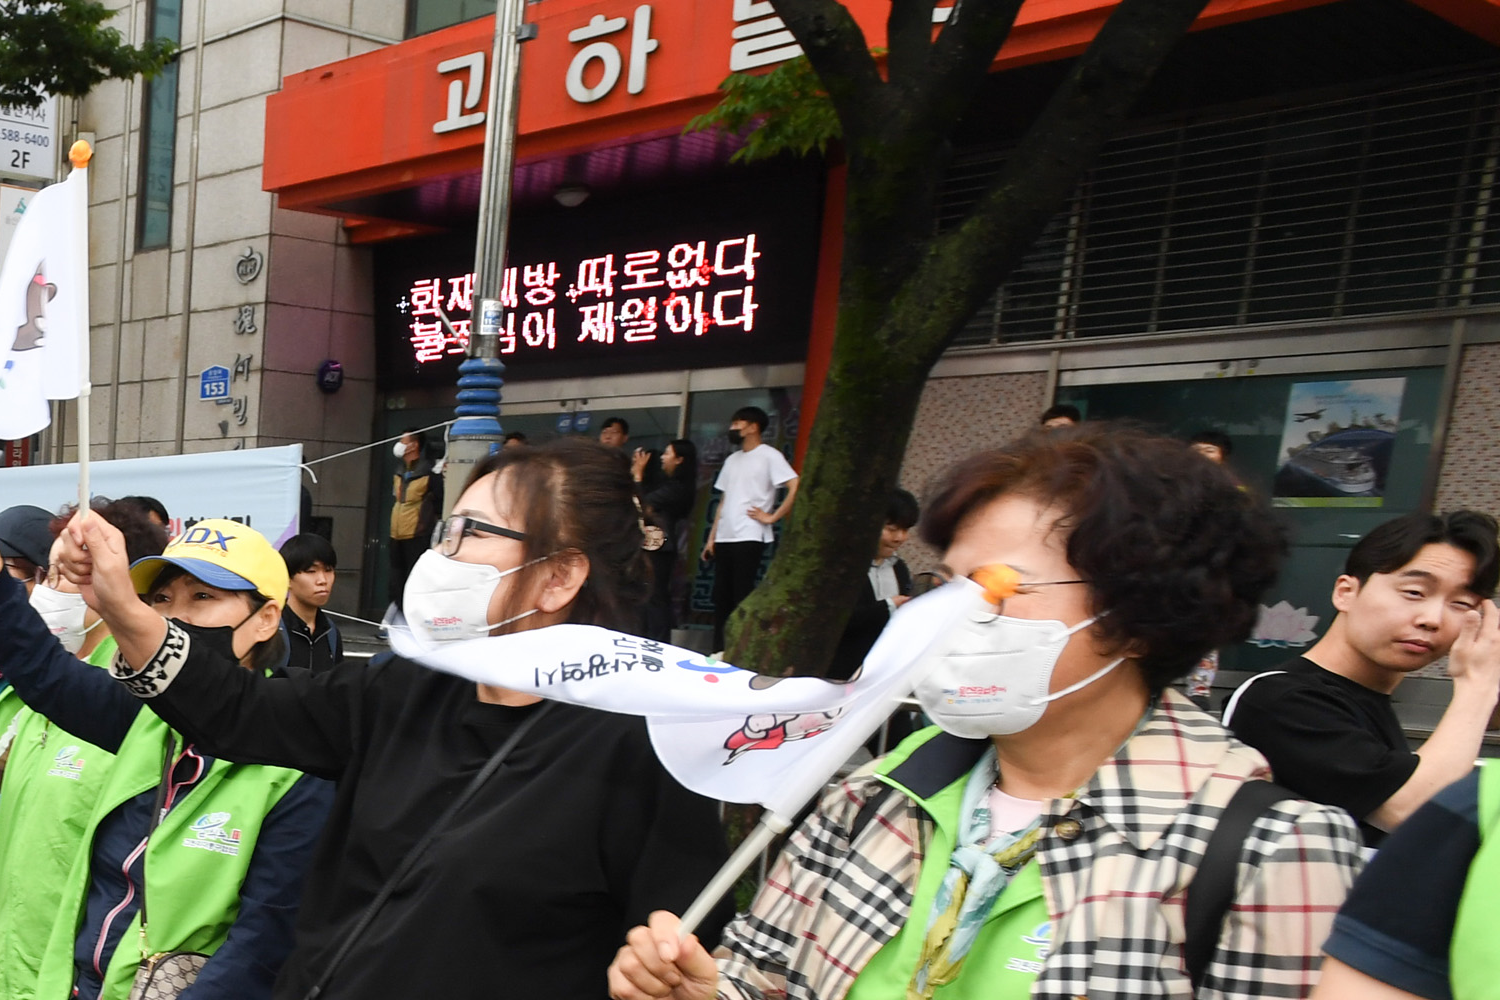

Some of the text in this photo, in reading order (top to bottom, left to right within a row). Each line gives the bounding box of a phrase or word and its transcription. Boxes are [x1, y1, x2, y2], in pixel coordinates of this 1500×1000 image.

[10, 149, 31, 170] 2F
[576, 233, 761, 297] 따로없다
[576, 285, 760, 344] 제일이다
[204, 381, 225, 396] 153
[534, 653, 666, 688] 울산광역시
